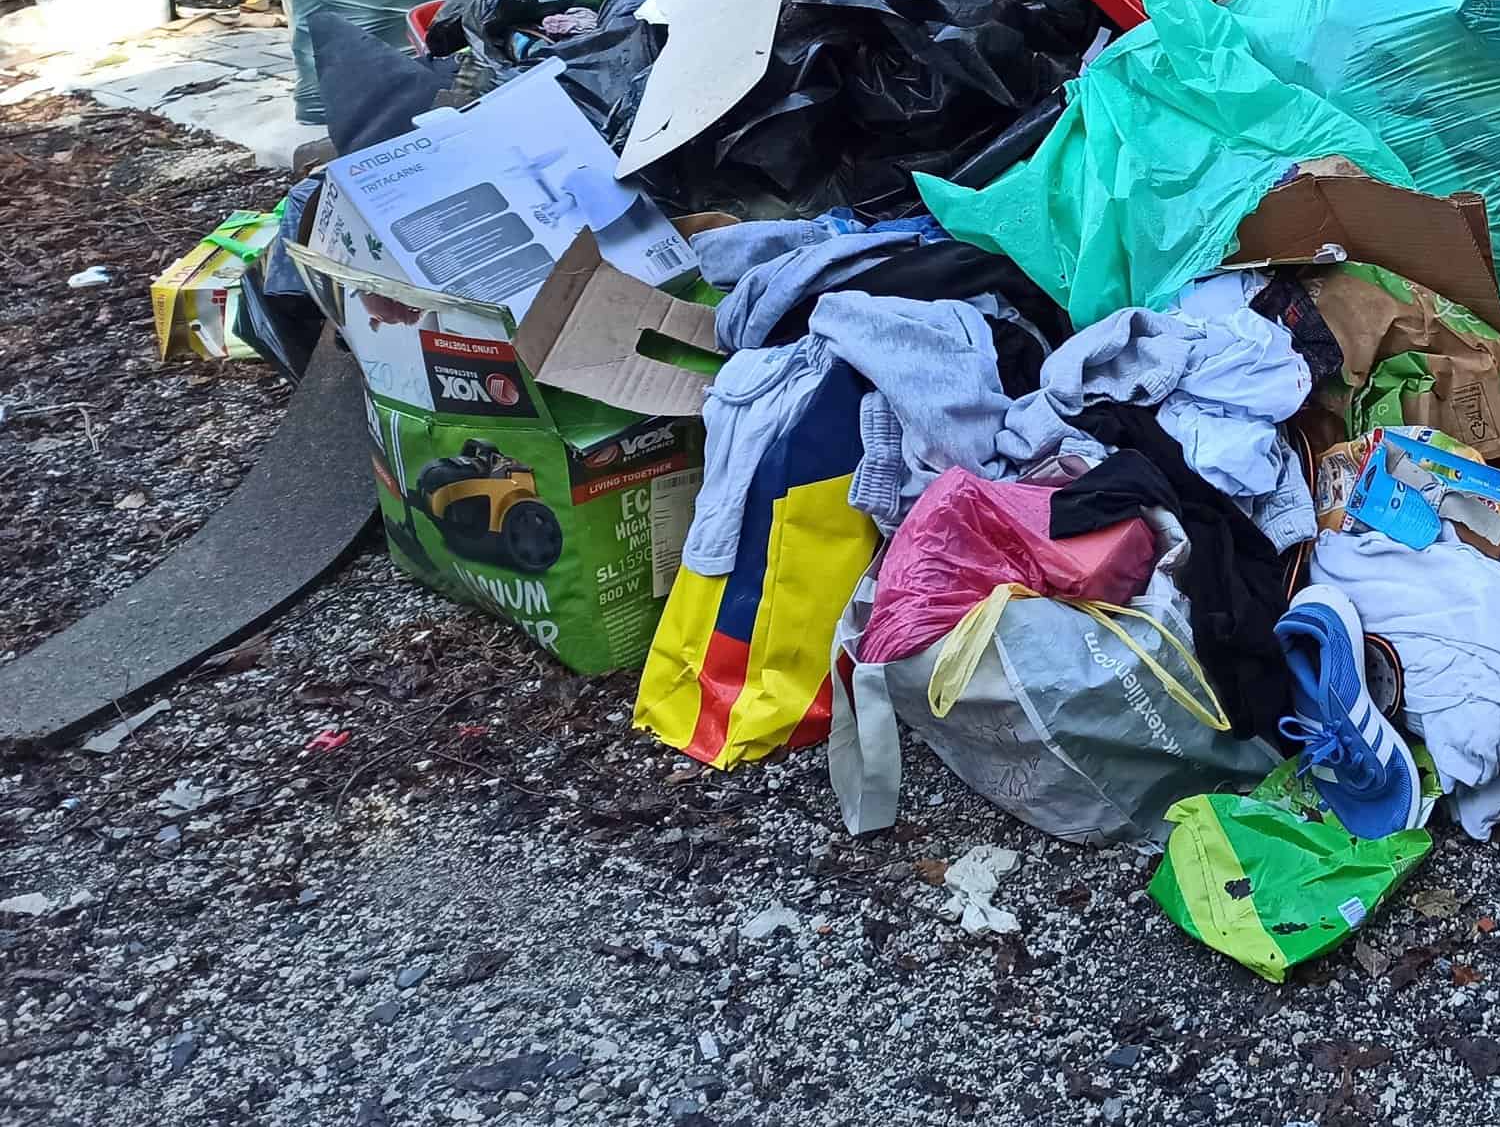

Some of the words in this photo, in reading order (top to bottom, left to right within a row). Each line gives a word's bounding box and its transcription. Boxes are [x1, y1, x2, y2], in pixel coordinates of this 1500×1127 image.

[350, 137, 432, 176] AMBIANO
[360, 163, 425, 195] TRITACARNE
[434, 338, 472, 353] TOGETHER
[472, 344, 499, 355] LIVING
[436, 374, 492, 403] VOX
[620, 423, 674, 456] VOX
[589, 476, 621, 495] LIVING
[622, 462, 673, 483] TOGETHER
[621, 488, 650, 521] EC
[599, 585, 624, 605] 800
[626, 577, 640, 593] W
